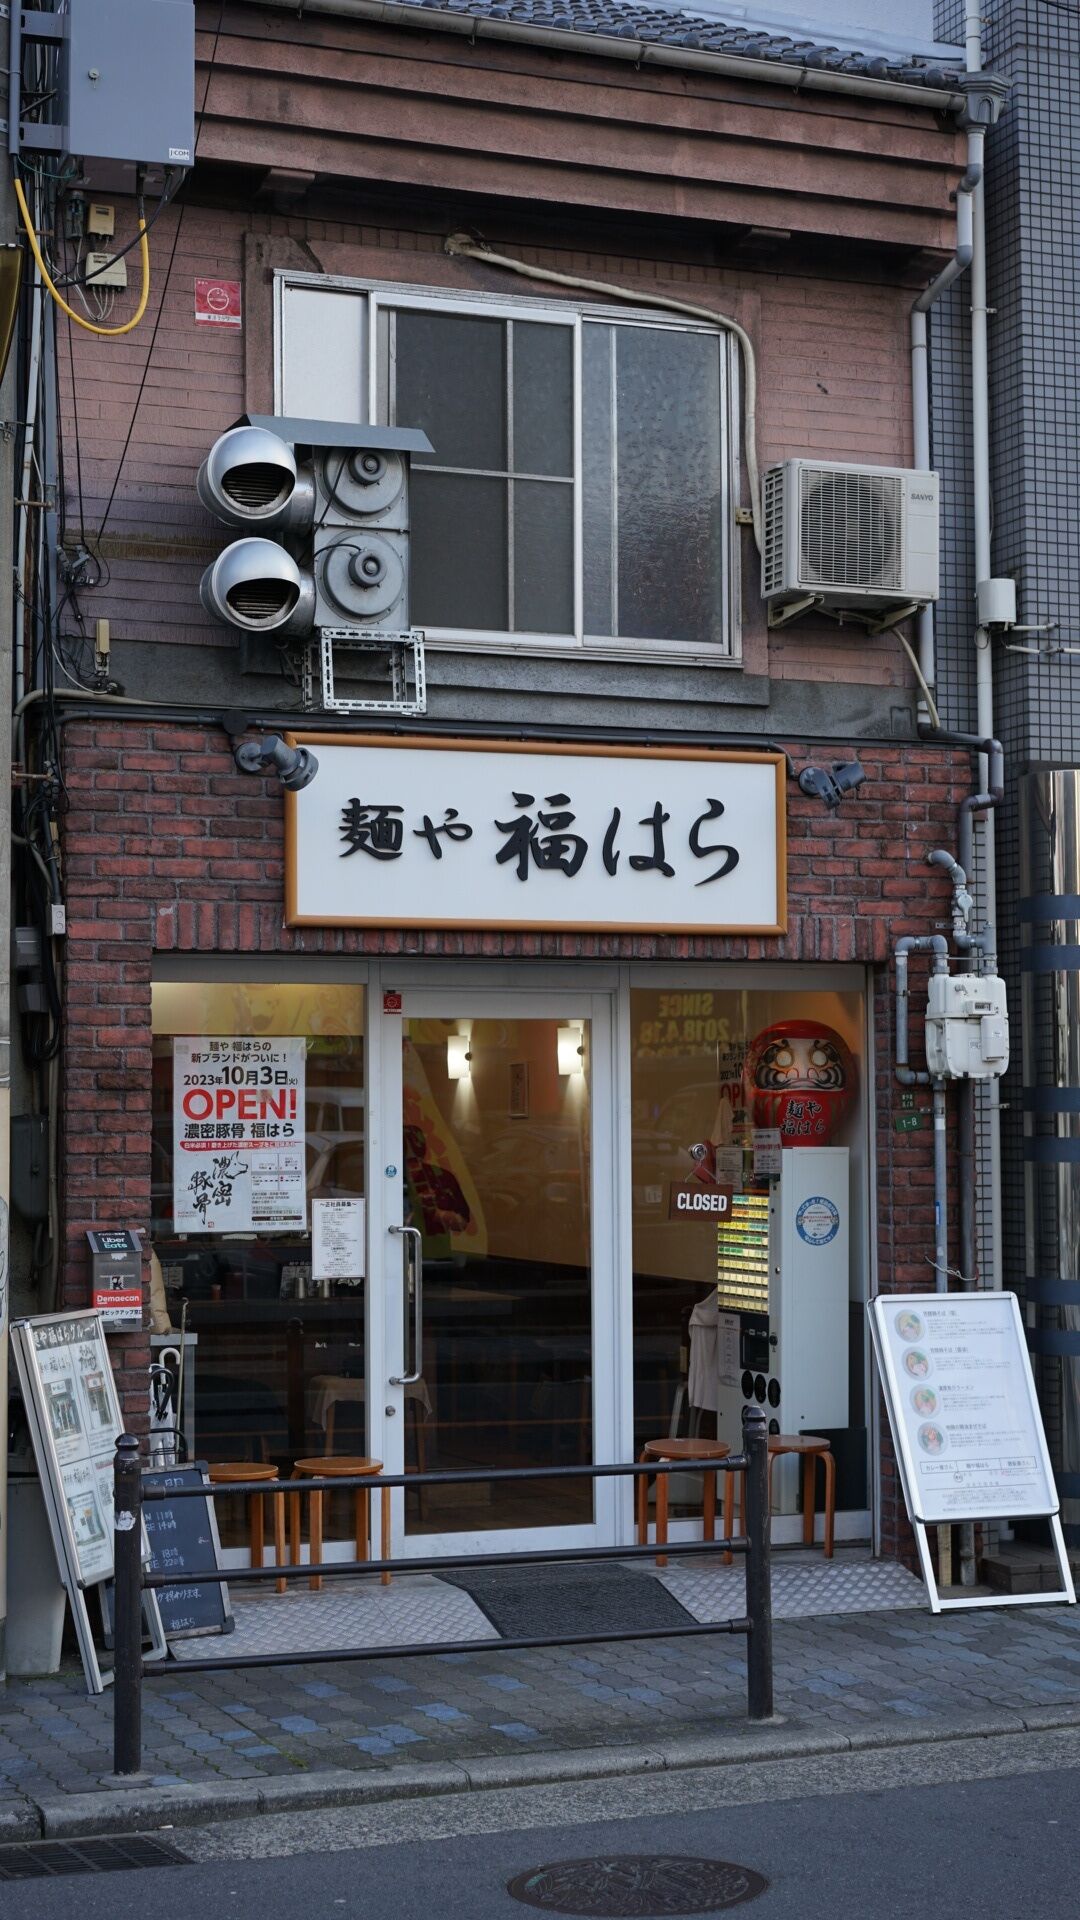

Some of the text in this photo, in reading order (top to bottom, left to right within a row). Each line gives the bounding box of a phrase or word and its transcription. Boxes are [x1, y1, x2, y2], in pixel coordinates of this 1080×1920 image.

[911, 493, 934, 501] SANYO
[182, 1088, 297, 1121] OPEN!
[786, 1100, 823, 1119] 麺や
[184, 1122, 295, 1139] 濃密豚骨 福はら
[780, 1120, 827, 1137] 福はら
[902, 1115, 917, 1129] 1-8
[676, 1192, 728, 1212] CLOSED
[96, 1295, 140, 1303] Demaecan
